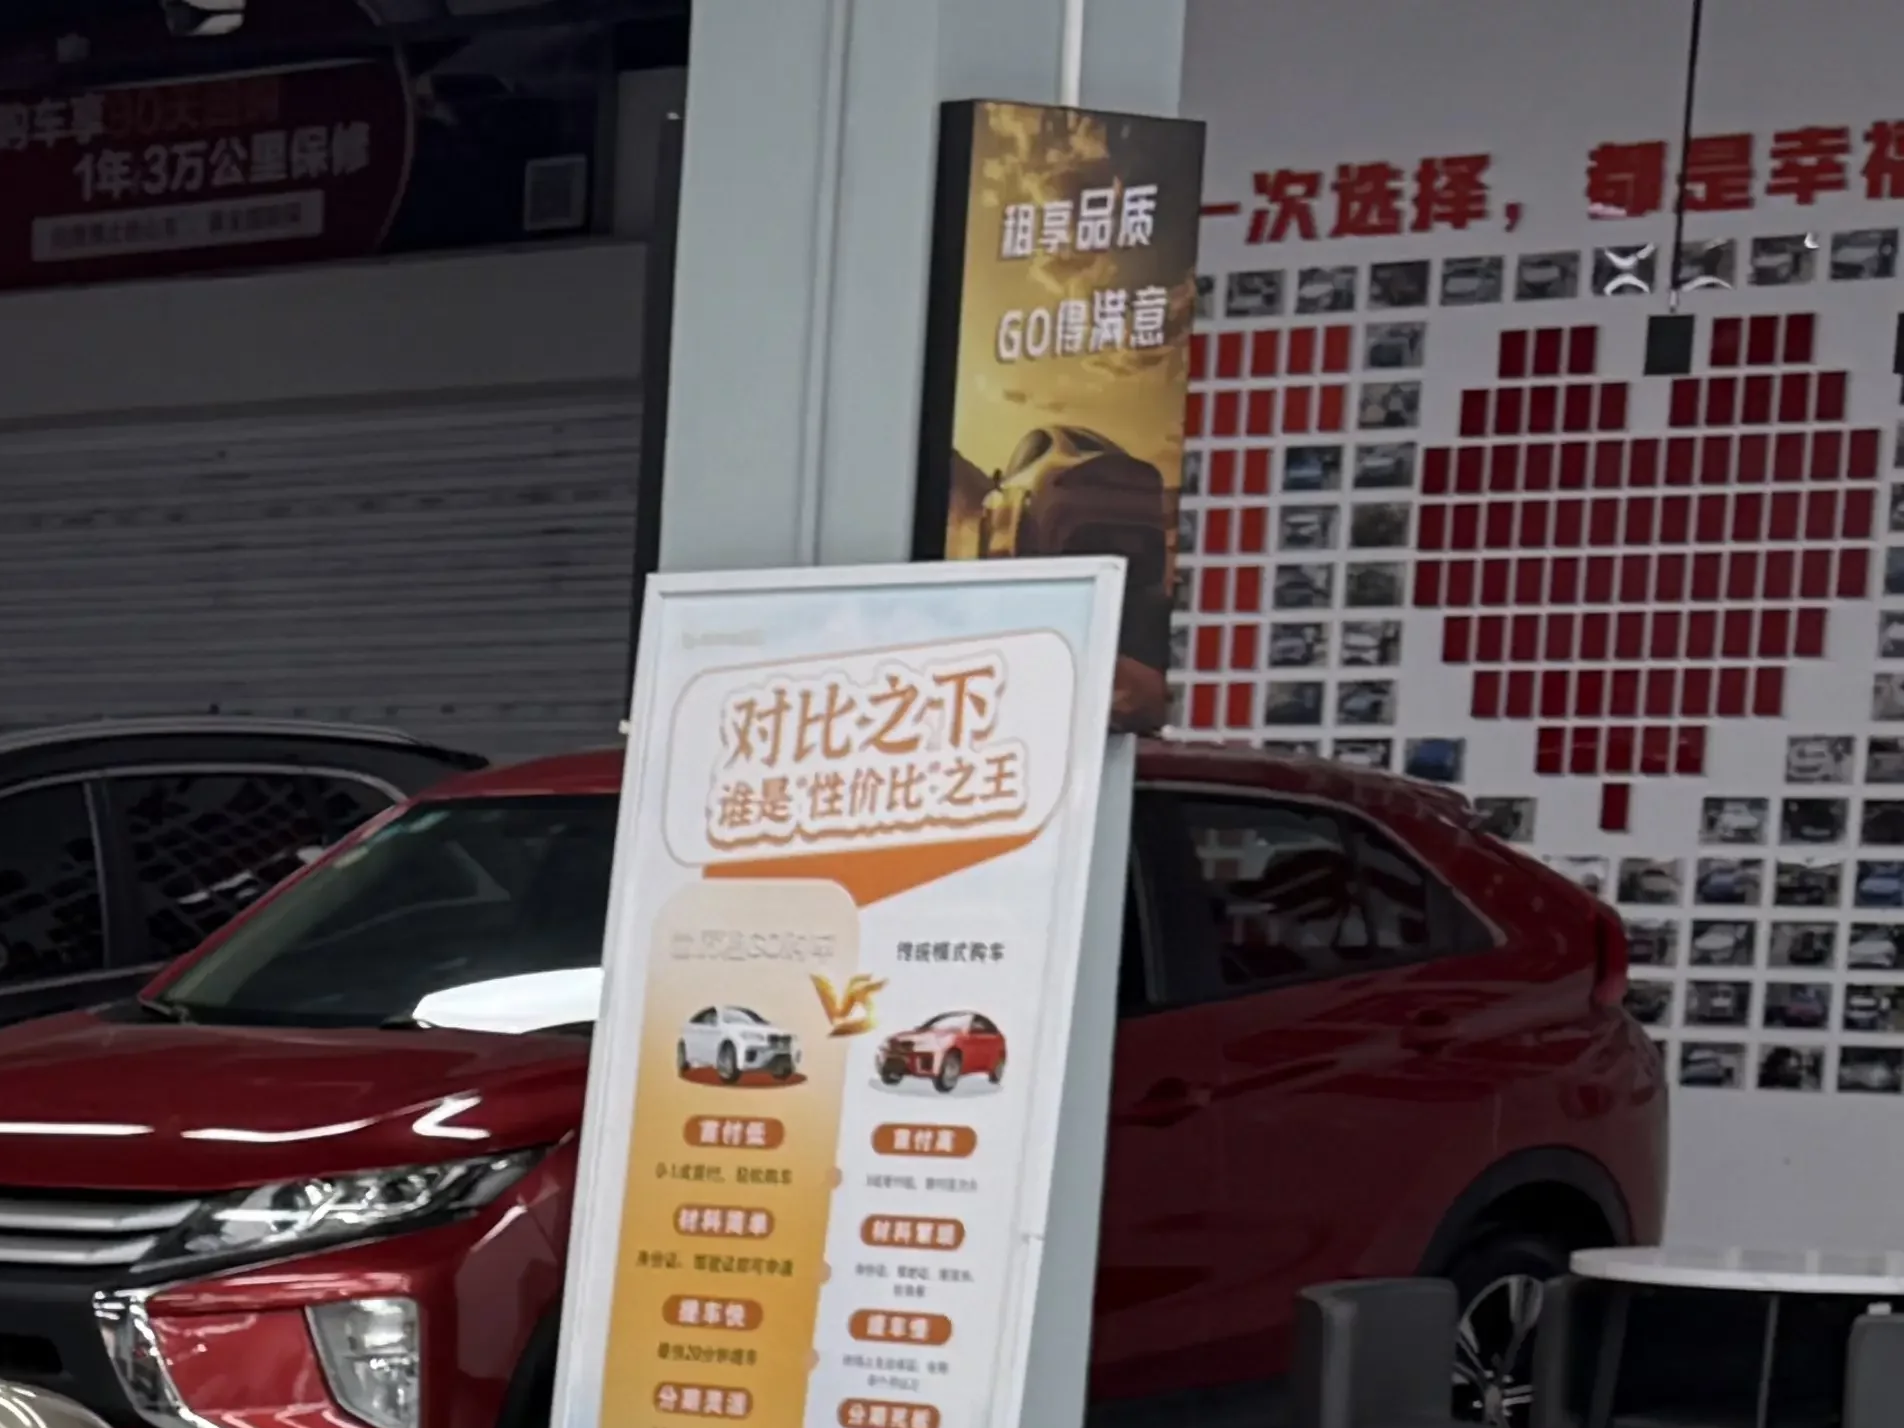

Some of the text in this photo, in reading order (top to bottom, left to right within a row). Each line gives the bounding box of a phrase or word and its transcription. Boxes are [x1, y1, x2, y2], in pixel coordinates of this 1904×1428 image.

[1002, 184, 1158, 258] 租享品质
[998, 286, 1168, 361] GO得满意
[729, 667, 997, 770] 对比之下
[809, 973, 889, 1038] VS
